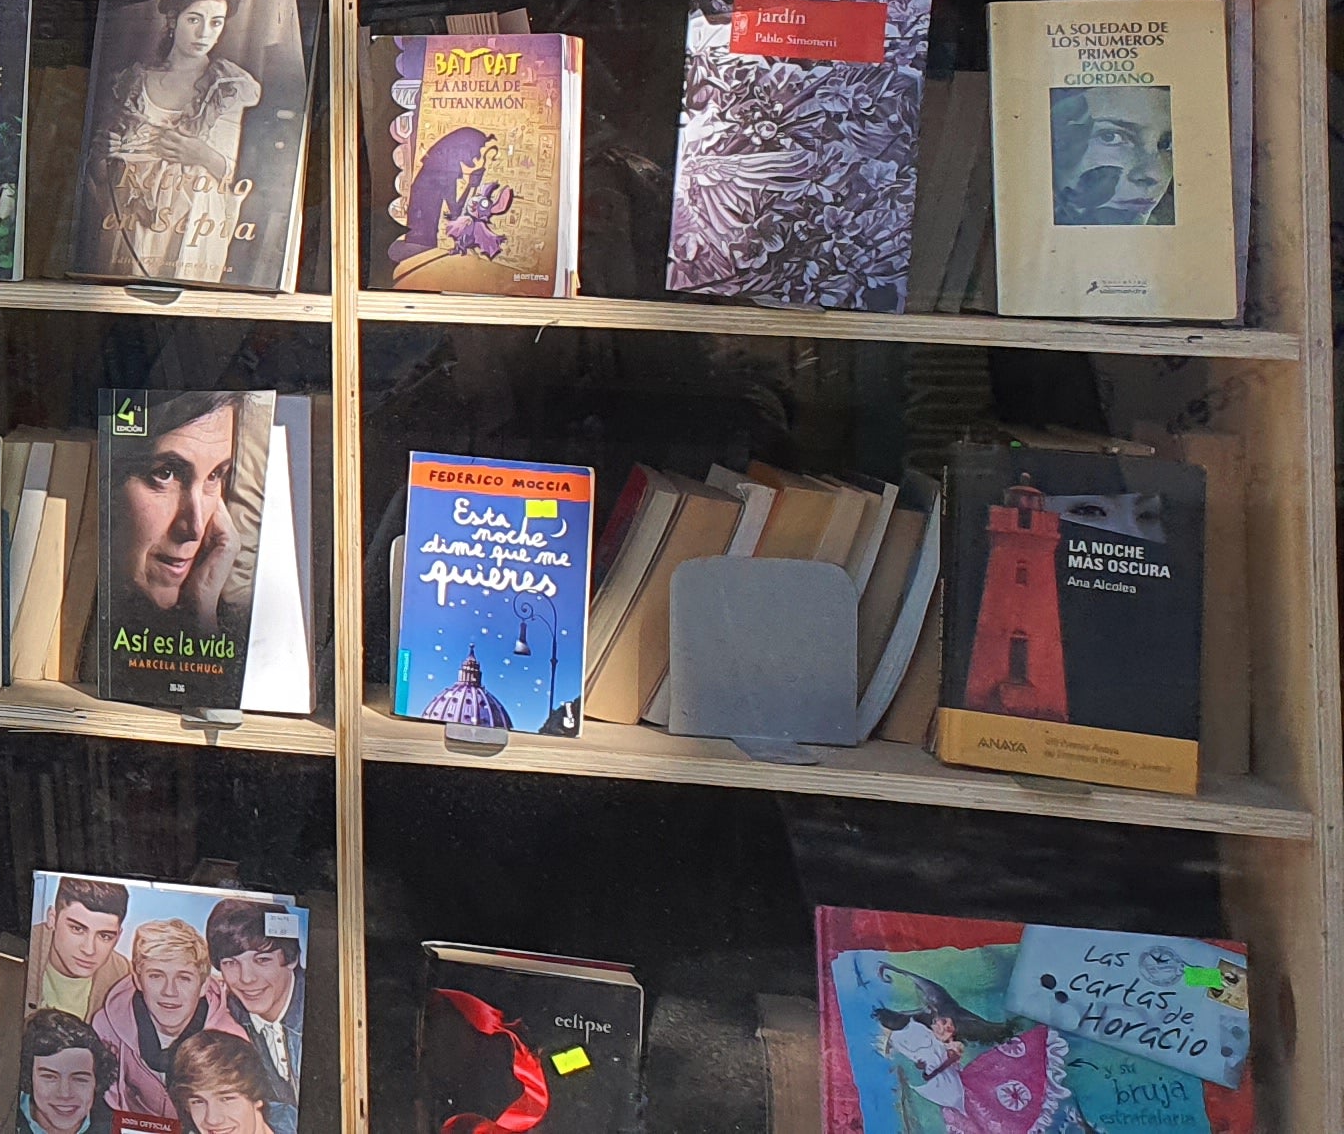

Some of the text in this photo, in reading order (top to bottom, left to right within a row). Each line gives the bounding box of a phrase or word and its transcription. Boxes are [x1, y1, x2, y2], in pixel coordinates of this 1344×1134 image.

[755, 7, 806, 26] jardín
[755, 32, 837, 47] Pablo Simonetti
[1046, 21, 1169, 36] LA SOLEDAD DE
[1051, 34, 1165, 48] LOS NUMEROS
[434, 47, 523, 77] BAT PAT
[1078, 47, 1139, 59] PRIMOS
[1082, 60, 1135, 72] PAOLO
[434, 80, 521, 93] LA ABUELA DE
[1064, 72, 1154, 85] GIORDANO
[430, 95, 526, 109] TUTANKAMÓN
[428, 469, 572, 493] FEDERICO MOCCIA
[453, 497, 511, 529] Esta
[471, 516, 548, 548] noche
[420, 533, 572, 567] dime que me
[1068, 539, 1145, 560] LA NOCHE
[1068, 553, 1172, 580] MÁS OSCURA
[419, 560, 558, 607] quieres
[1067, 576, 1138, 595] Ana Alcolea
[113, 626, 235, 659] Así es la vida
[128, 658, 225, 675] MARCELA LECHUGA
[1084, 944, 1131, 968] Las
[1069, 973, 1177, 1011] cartas
[1162, 1005, 1195, 1025] de
[554, 1013, 612, 1044] eclipse
[1077, 1002, 1209, 1057] Horacio
[1113, 1076, 1190, 1108] bruja
